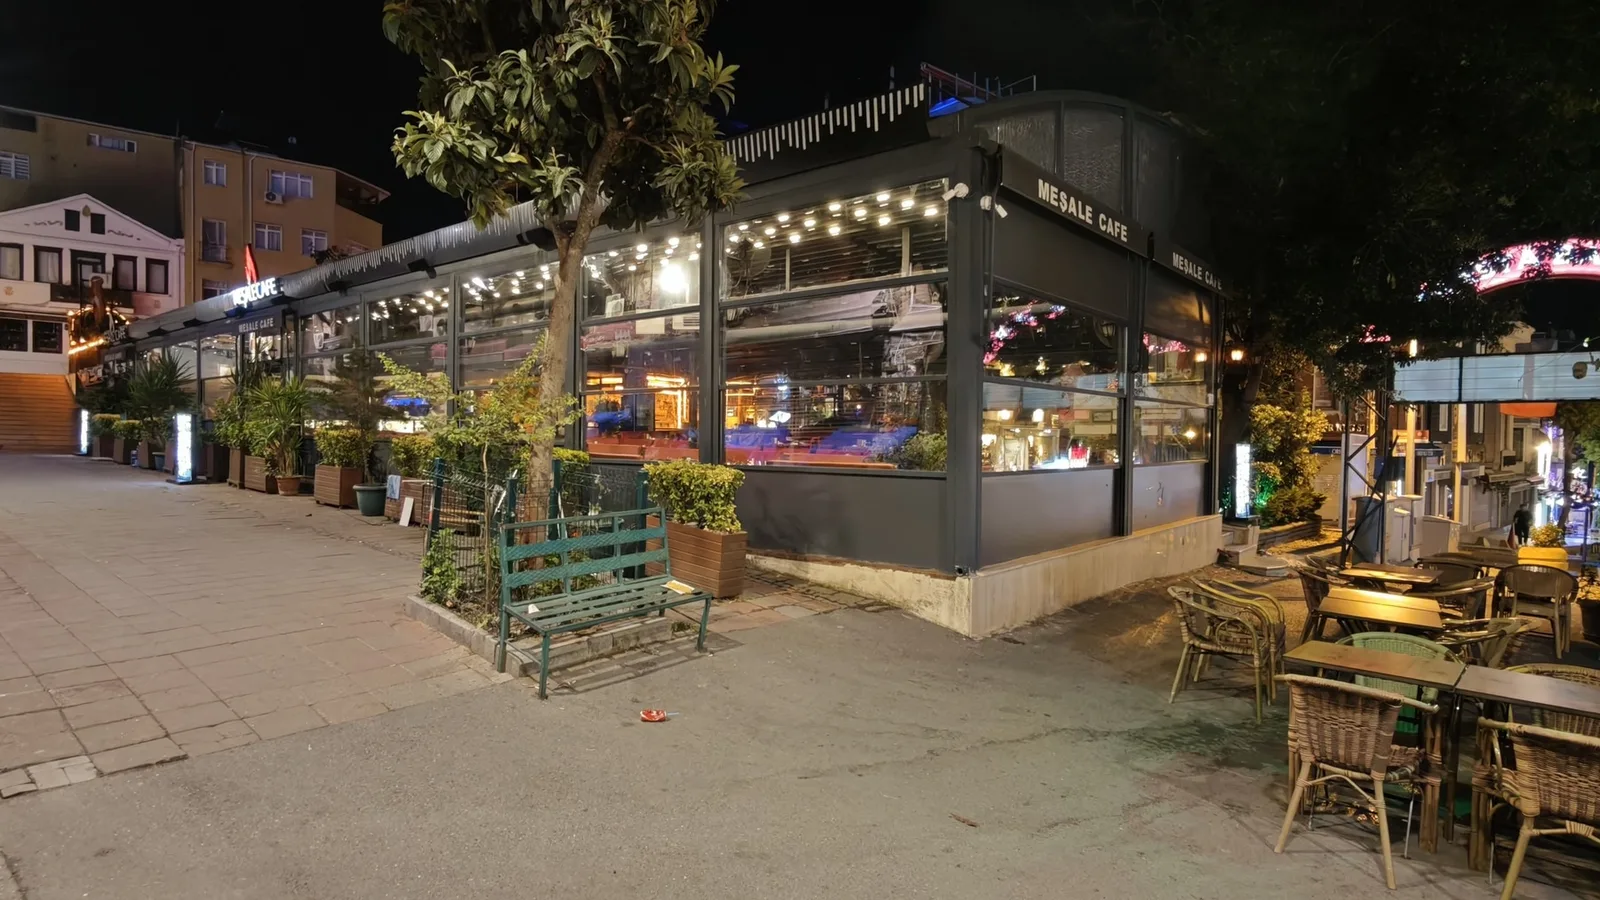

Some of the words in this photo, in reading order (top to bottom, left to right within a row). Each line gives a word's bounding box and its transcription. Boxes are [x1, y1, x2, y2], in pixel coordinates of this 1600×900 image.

[1038, 178, 1093, 225] MEŞALE
[1098, 212, 1128, 243] CAFE
[1173, 251, 1202, 280] MEŞALE
[260, 317, 274, 328] CAFE
